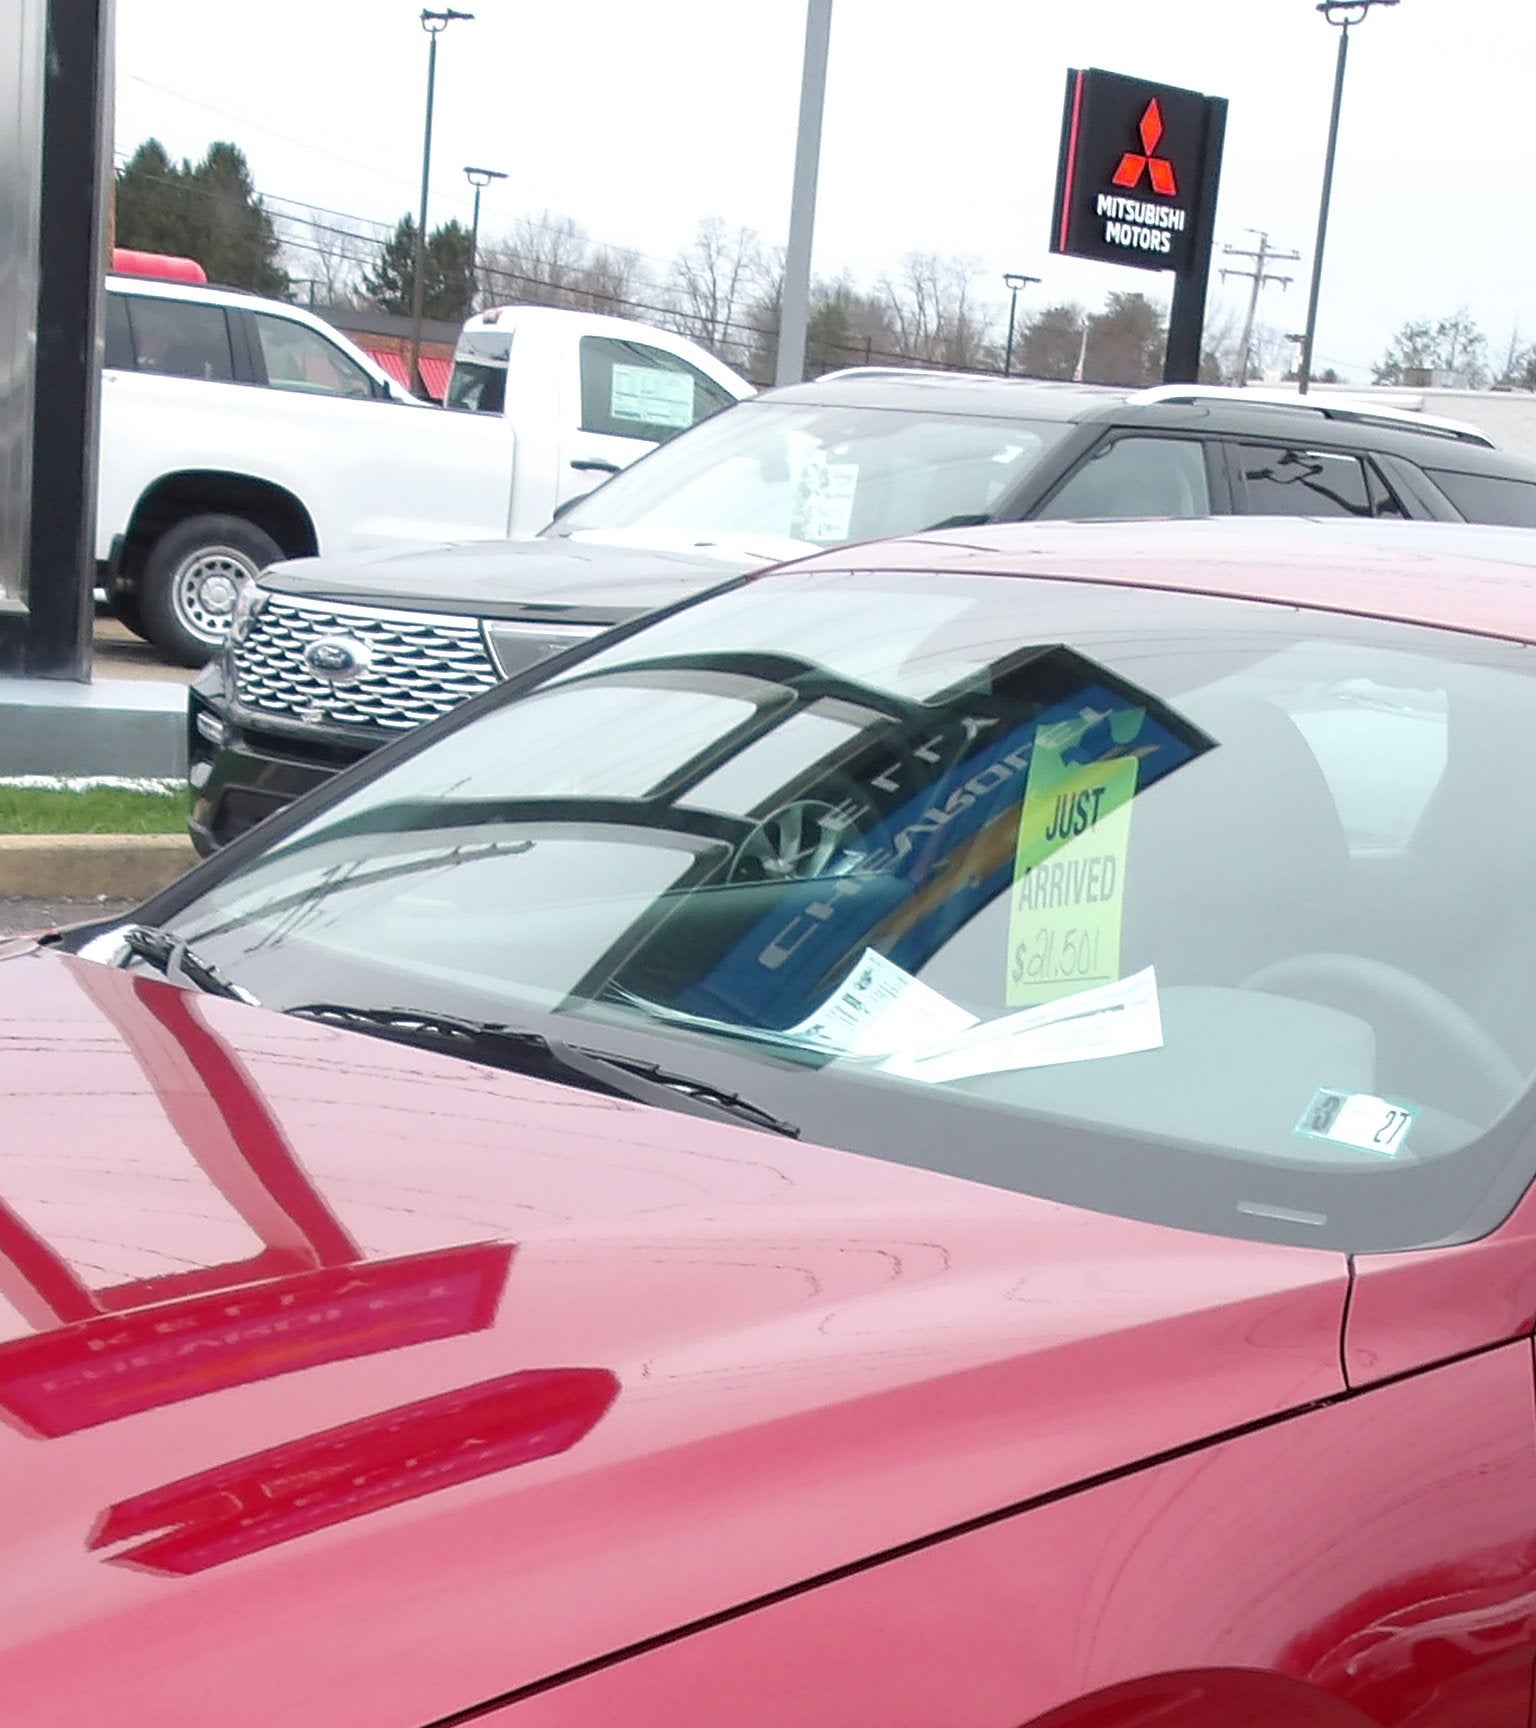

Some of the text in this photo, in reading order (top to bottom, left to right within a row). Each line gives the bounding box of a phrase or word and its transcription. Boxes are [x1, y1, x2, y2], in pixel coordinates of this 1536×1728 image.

[1097, 193, 1185, 231] MITSUBISHI
[1105, 220, 1171, 253] MOTORS
[1045, 787, 1107, 841] JUST
[1018, 855, 1117, 911] ARRIVED
[1372, 1110, 1410, 1145] 27
